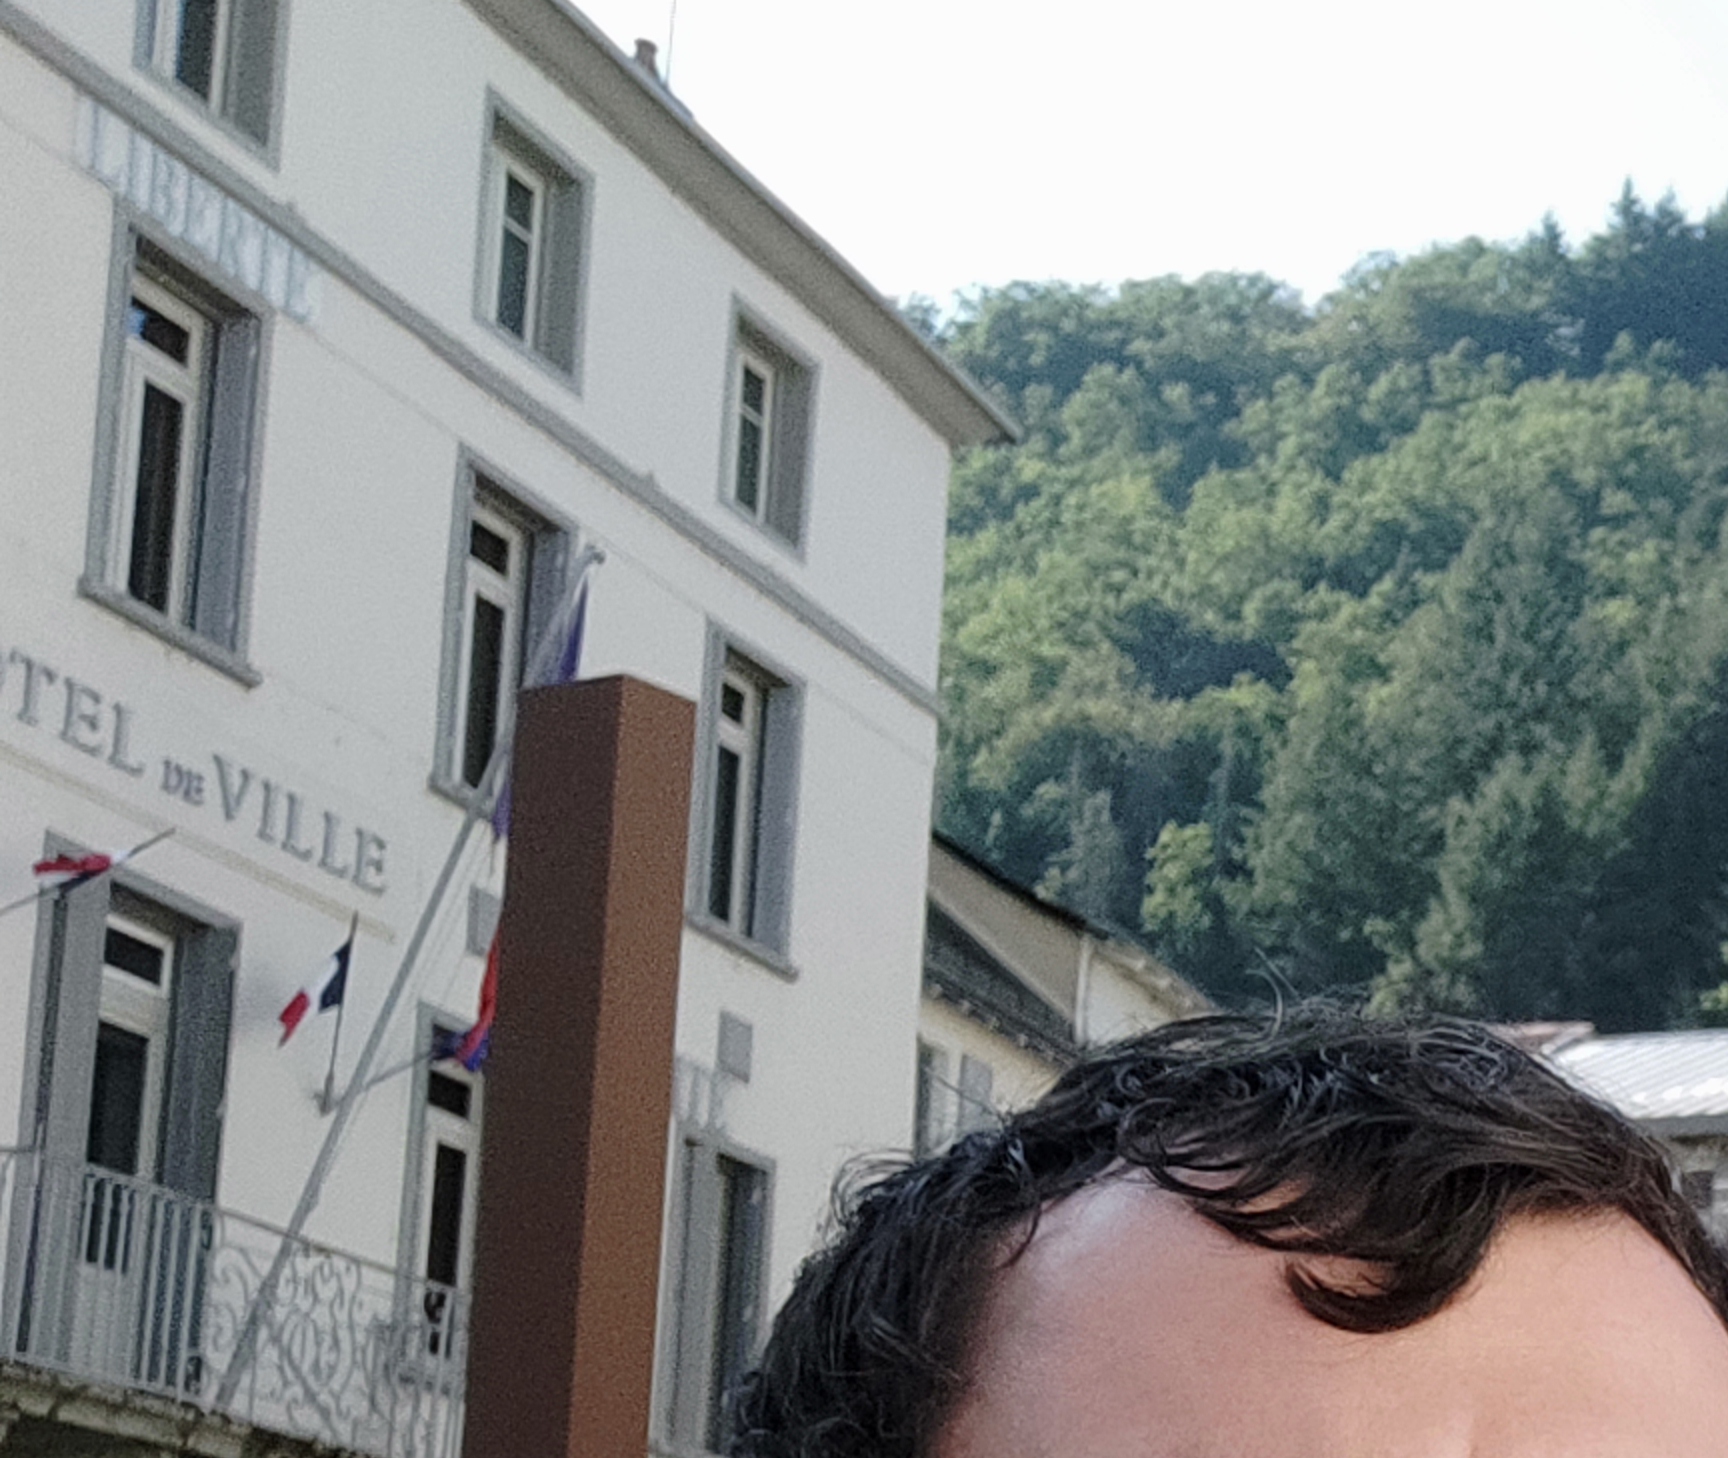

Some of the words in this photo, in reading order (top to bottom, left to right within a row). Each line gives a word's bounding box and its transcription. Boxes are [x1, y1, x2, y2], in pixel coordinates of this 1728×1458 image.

[0, 647, 145, 777] TEL
[161, 757, 206, 807] DE
[212, 753, 389, 895] VILLE
